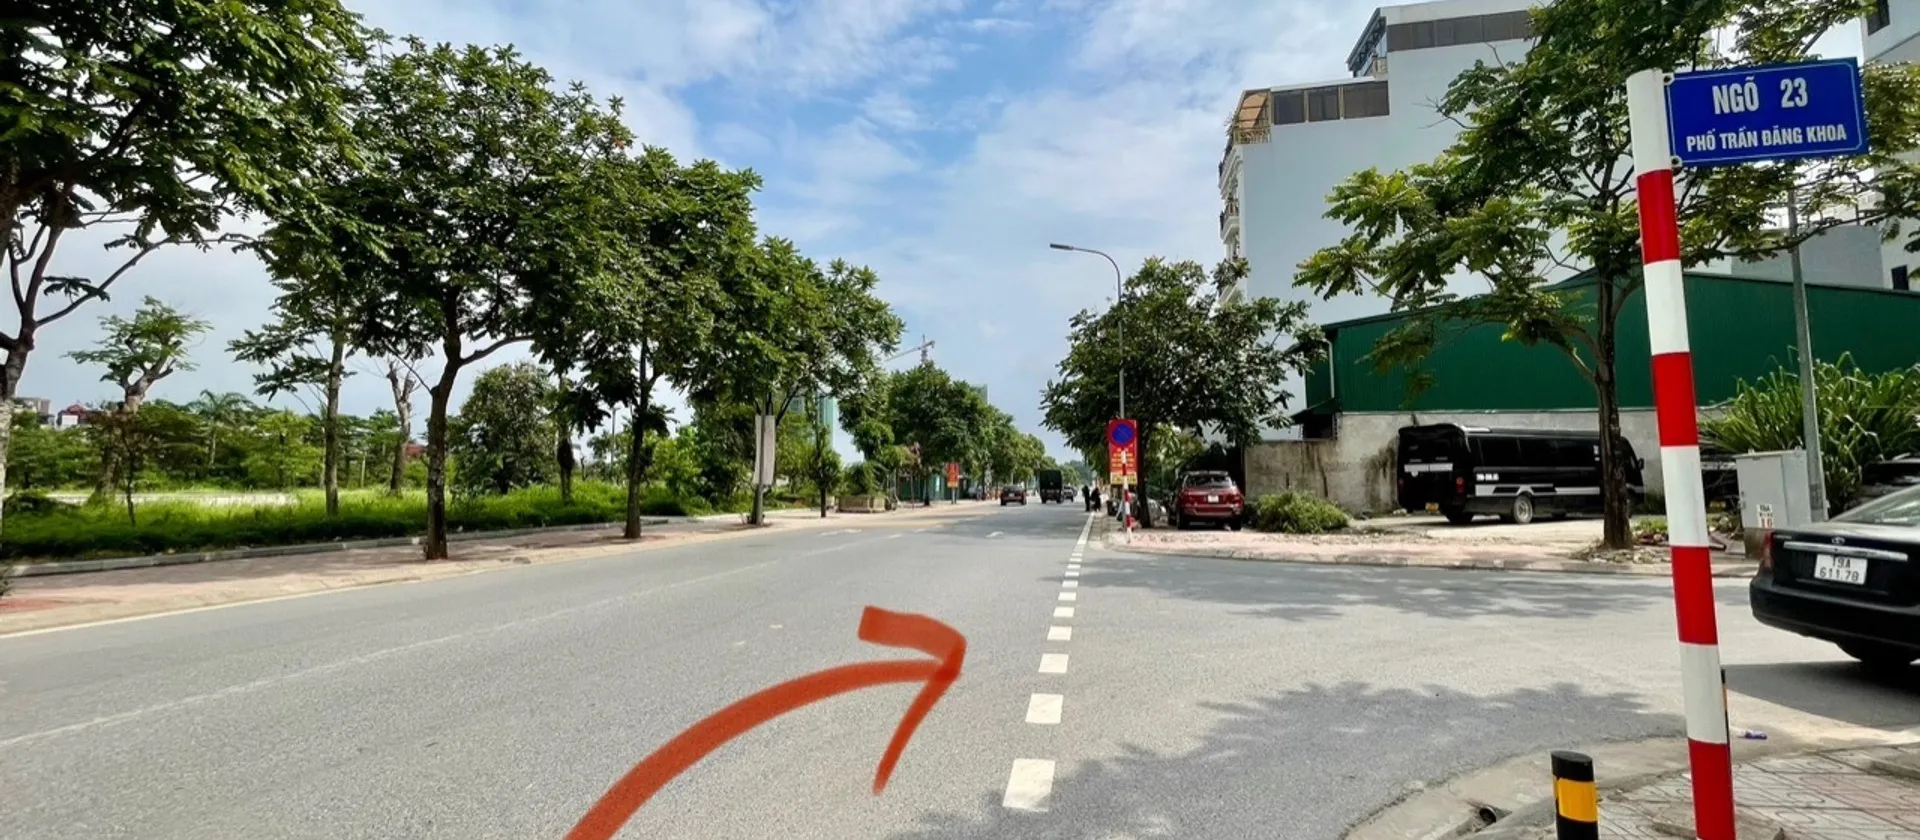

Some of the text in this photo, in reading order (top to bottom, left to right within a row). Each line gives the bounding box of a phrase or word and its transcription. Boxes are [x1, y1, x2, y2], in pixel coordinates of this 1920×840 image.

[1712, 76, 1808, 115] NGÕ 23
[1686, 128, 1716, 152] PHỐ
[1762, 125, 1803, 147] ĐĂNG
[1805, 124, 1847, 143] KHOA
